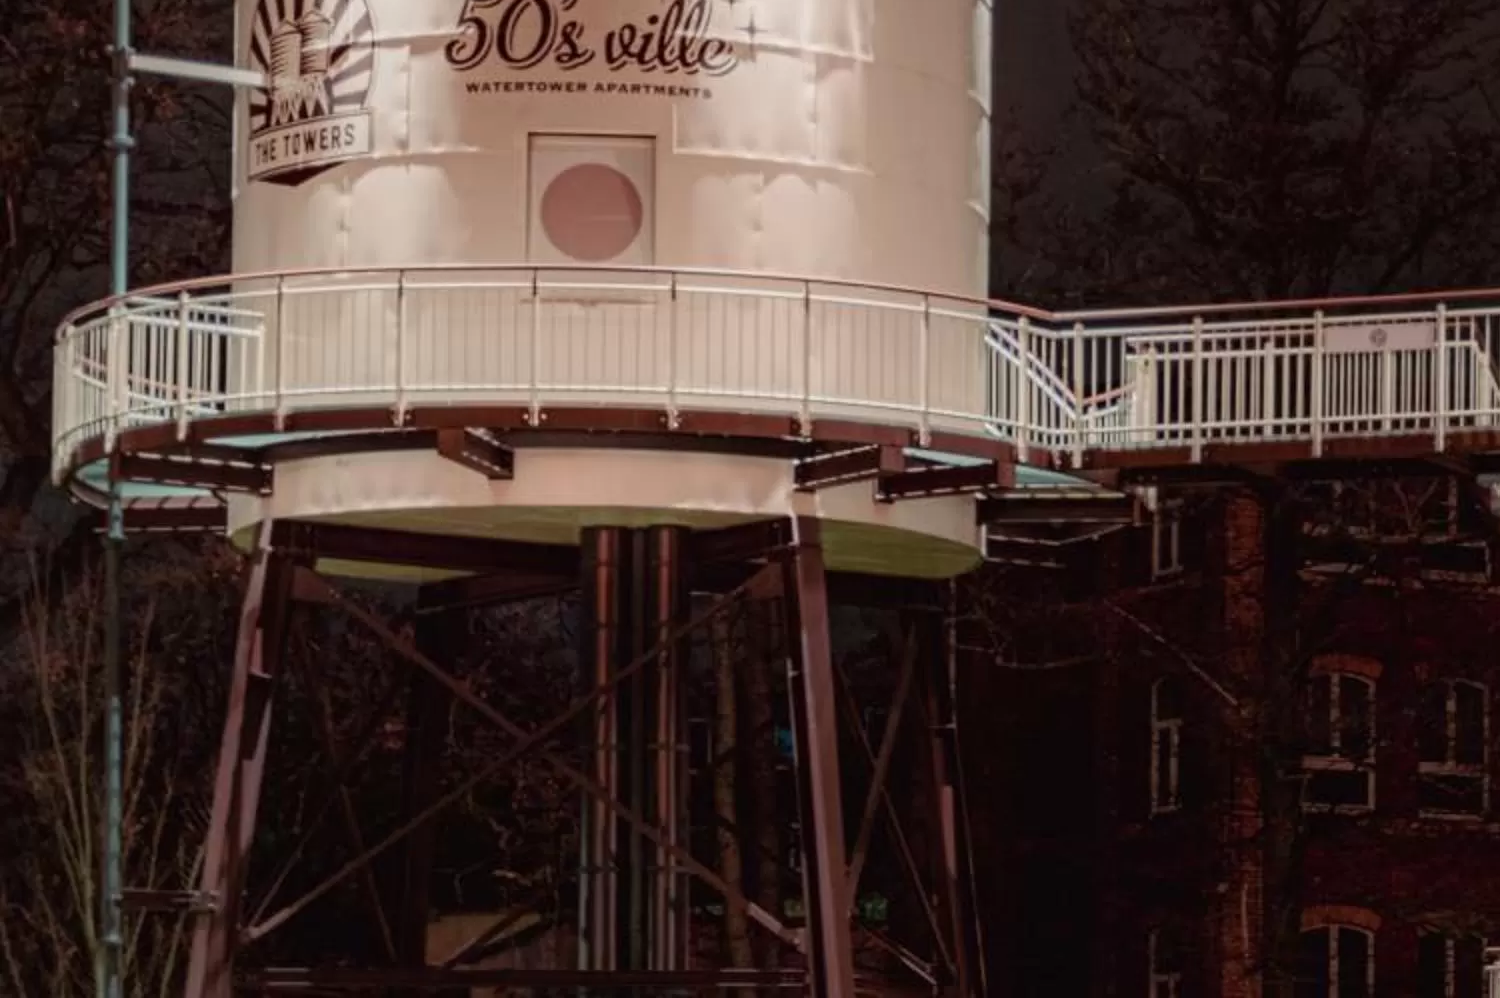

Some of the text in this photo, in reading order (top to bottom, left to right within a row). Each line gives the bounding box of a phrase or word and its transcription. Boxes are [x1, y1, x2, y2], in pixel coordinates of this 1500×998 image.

[466, 80, 713, 100] WATERTOWER APARTMENTS
[255, 123, 356, 166] THE TOWERS
